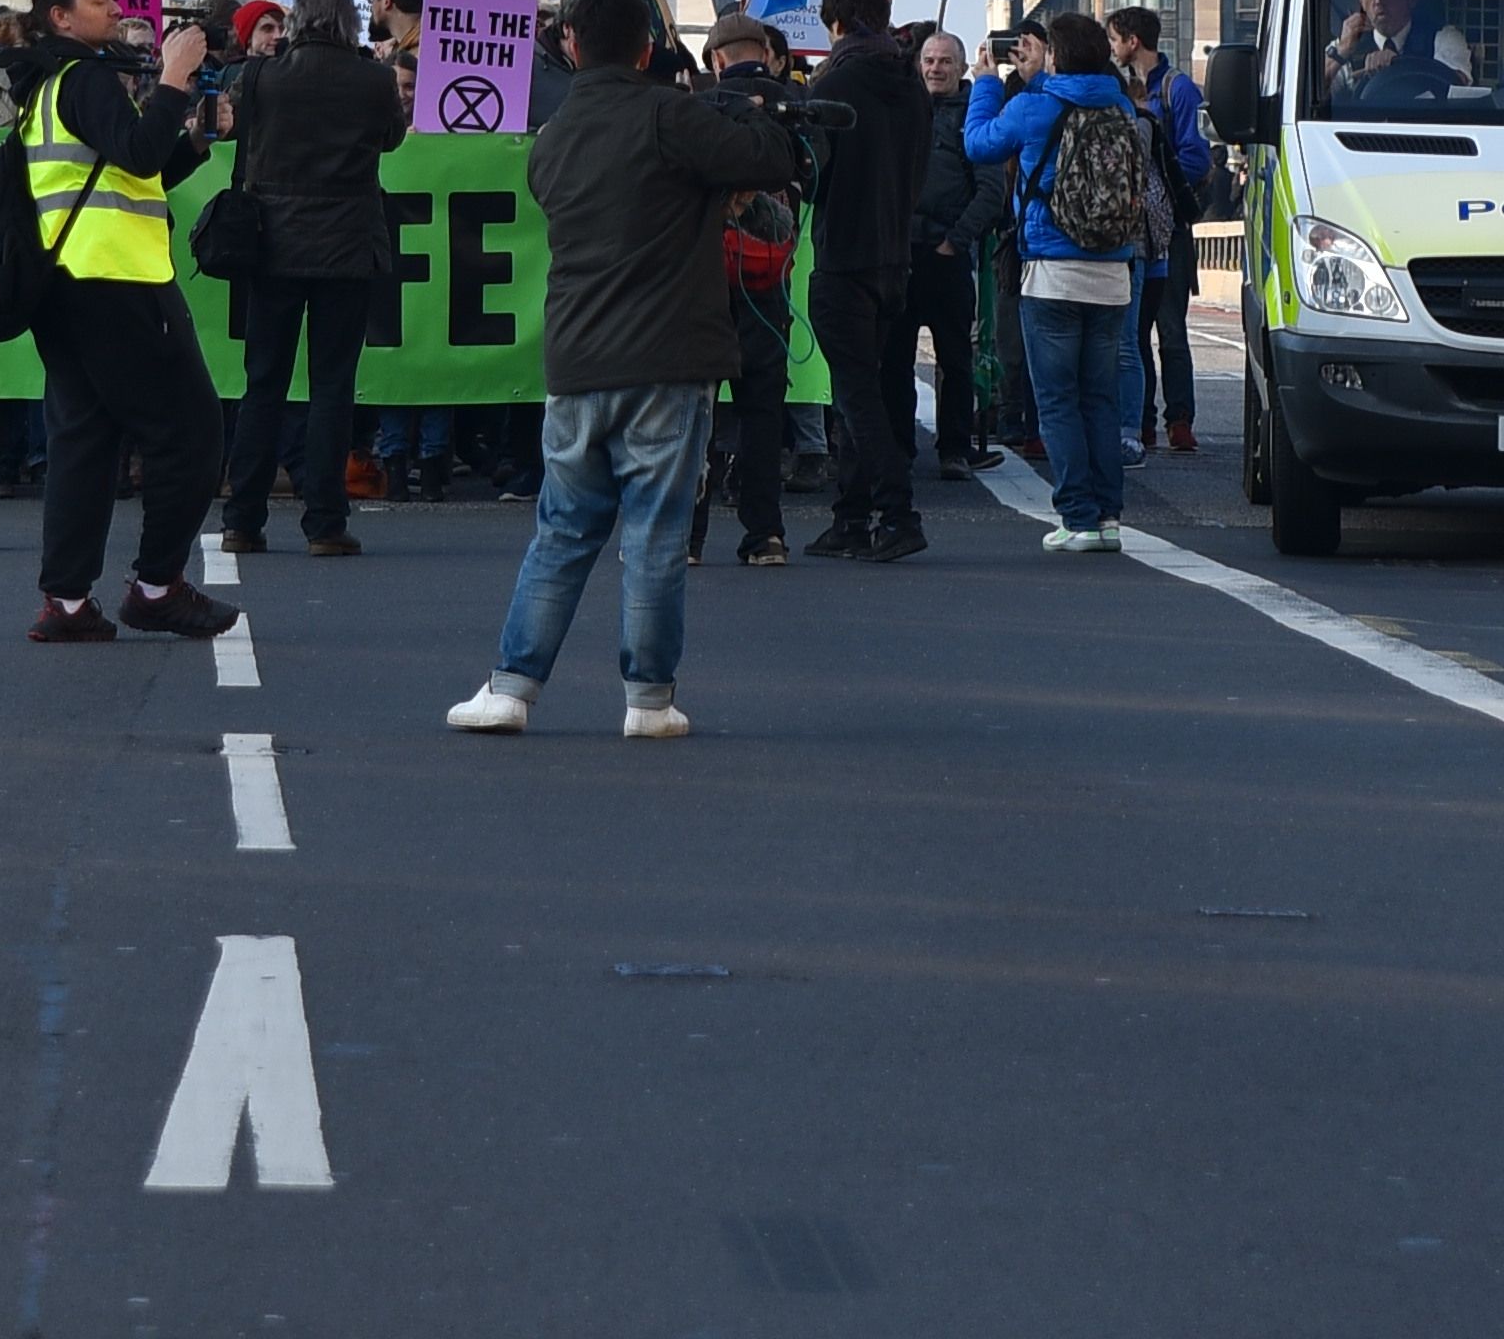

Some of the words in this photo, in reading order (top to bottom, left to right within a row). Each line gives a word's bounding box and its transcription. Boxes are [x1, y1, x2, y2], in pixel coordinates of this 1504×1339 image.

[428, 6, 477, 34] TELL
[488, 11, 532, 39] THE
[439, 37, 515, 68] TRUTH
